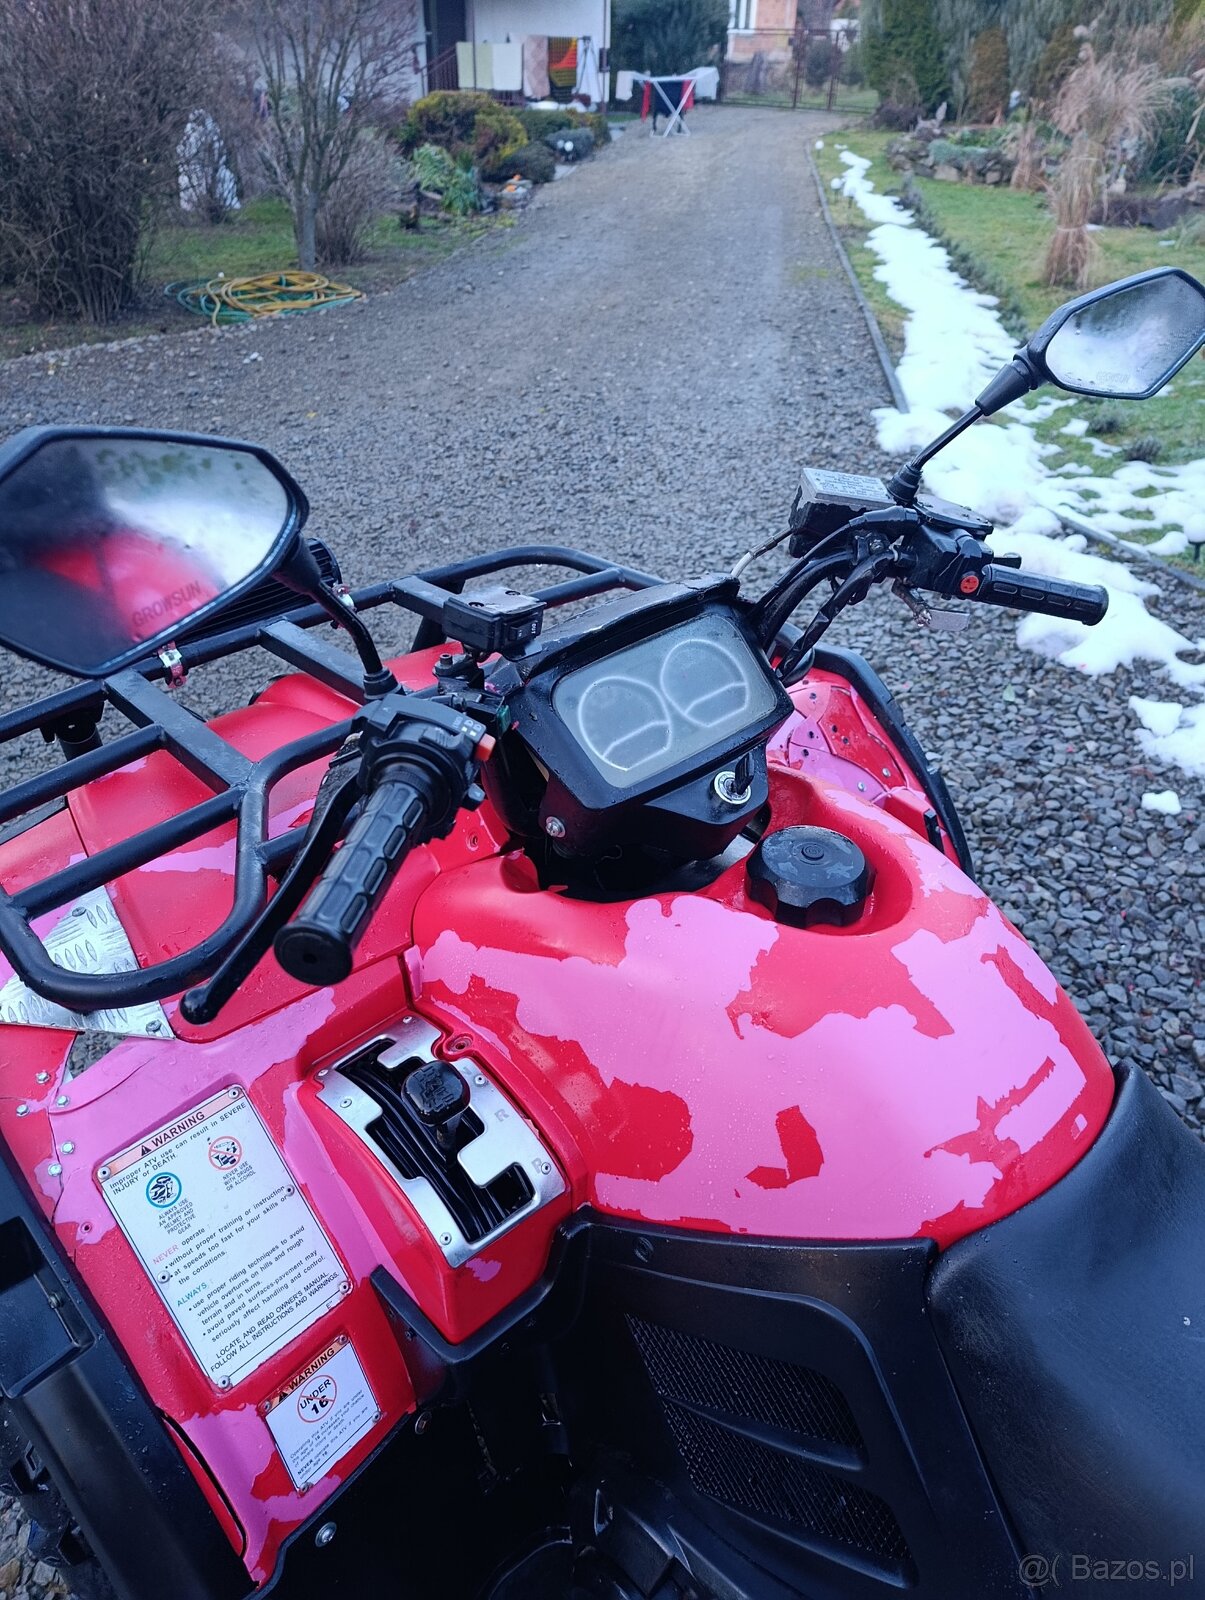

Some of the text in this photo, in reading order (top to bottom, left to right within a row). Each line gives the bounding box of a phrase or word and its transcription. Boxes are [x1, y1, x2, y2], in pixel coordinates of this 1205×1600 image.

[132, 580, 201, 627] GROWSUN
[109, 1168, 141, 1189] Improper
[144, 1157, 157, 1169] ATV
[160, 1149, 173, 1158] use
[175, 1139, 188, 1149] can
[190, 1126, 209, 1140] result
[220, 1102, 246, 1121] SEVERE
[152, 1111, 206, 1148] WARNING
[113, 1175, 139, 1195] INJURY
[223, 1161, 248, 1180] NEVER USE
[236, 1165, 253, 1178] DRUGS
[178, 1198, 188, 1207] USE
[169, 1186, 285, 1267] without proper training or instruction
[178, 1223, 191, 1235] GEAR
[183, 1252, 206, 1269] speeds
[208, 1243, 219, 1252] too
[221, 1232, 234, 1243] fast
[235, 1225, 244, 1234] for
[246, 1214, 260, 1227] your
[263, 1202, 278, 1215] skills
[152, 1228, 205, 1265] NEVER operate
[178, 1251, 227, 1285] the conditions.
[193, 1299, 204, 1309] use
[207, 1282, 226, 1300] proper
[229, 1268, 247, 1283] riding
[247, 1245, 279, 1269] techniques
[290, 1225, 305, 1239] avoid
[197, 1238, 304, 1317] vehicle overturns on hills and rough
[177, 1282, 207, 1307] ALWAYS
[207, 1318, 225, 1334] avoid
[227, 1302, 246, 1320] paved
[305, 1250, 317, 1261] may
[212, 1255, 326, 1342] seriously affect handling and control.
[201, 1309, 222, 1325] terrain
[224, 1298, 236, 1310] and
[210, 1348, 237, 1372] FOLLOW
[239, 1340, 252, 1351] ALL
[251, 1306, 294, 1341] INSTRUCTIONS
[295, 1296, 307, 1308] AND
[216, 1337, 242, 1359] LOCATE
[243, 1326, 256, 1339] AND
[257, 1312, 274, 1327] READ
[289, 1347, 336, 1391] WARNING
[300, 1379, 331, 1409] UNDER
[311, 1395, 329, 1414] 16
